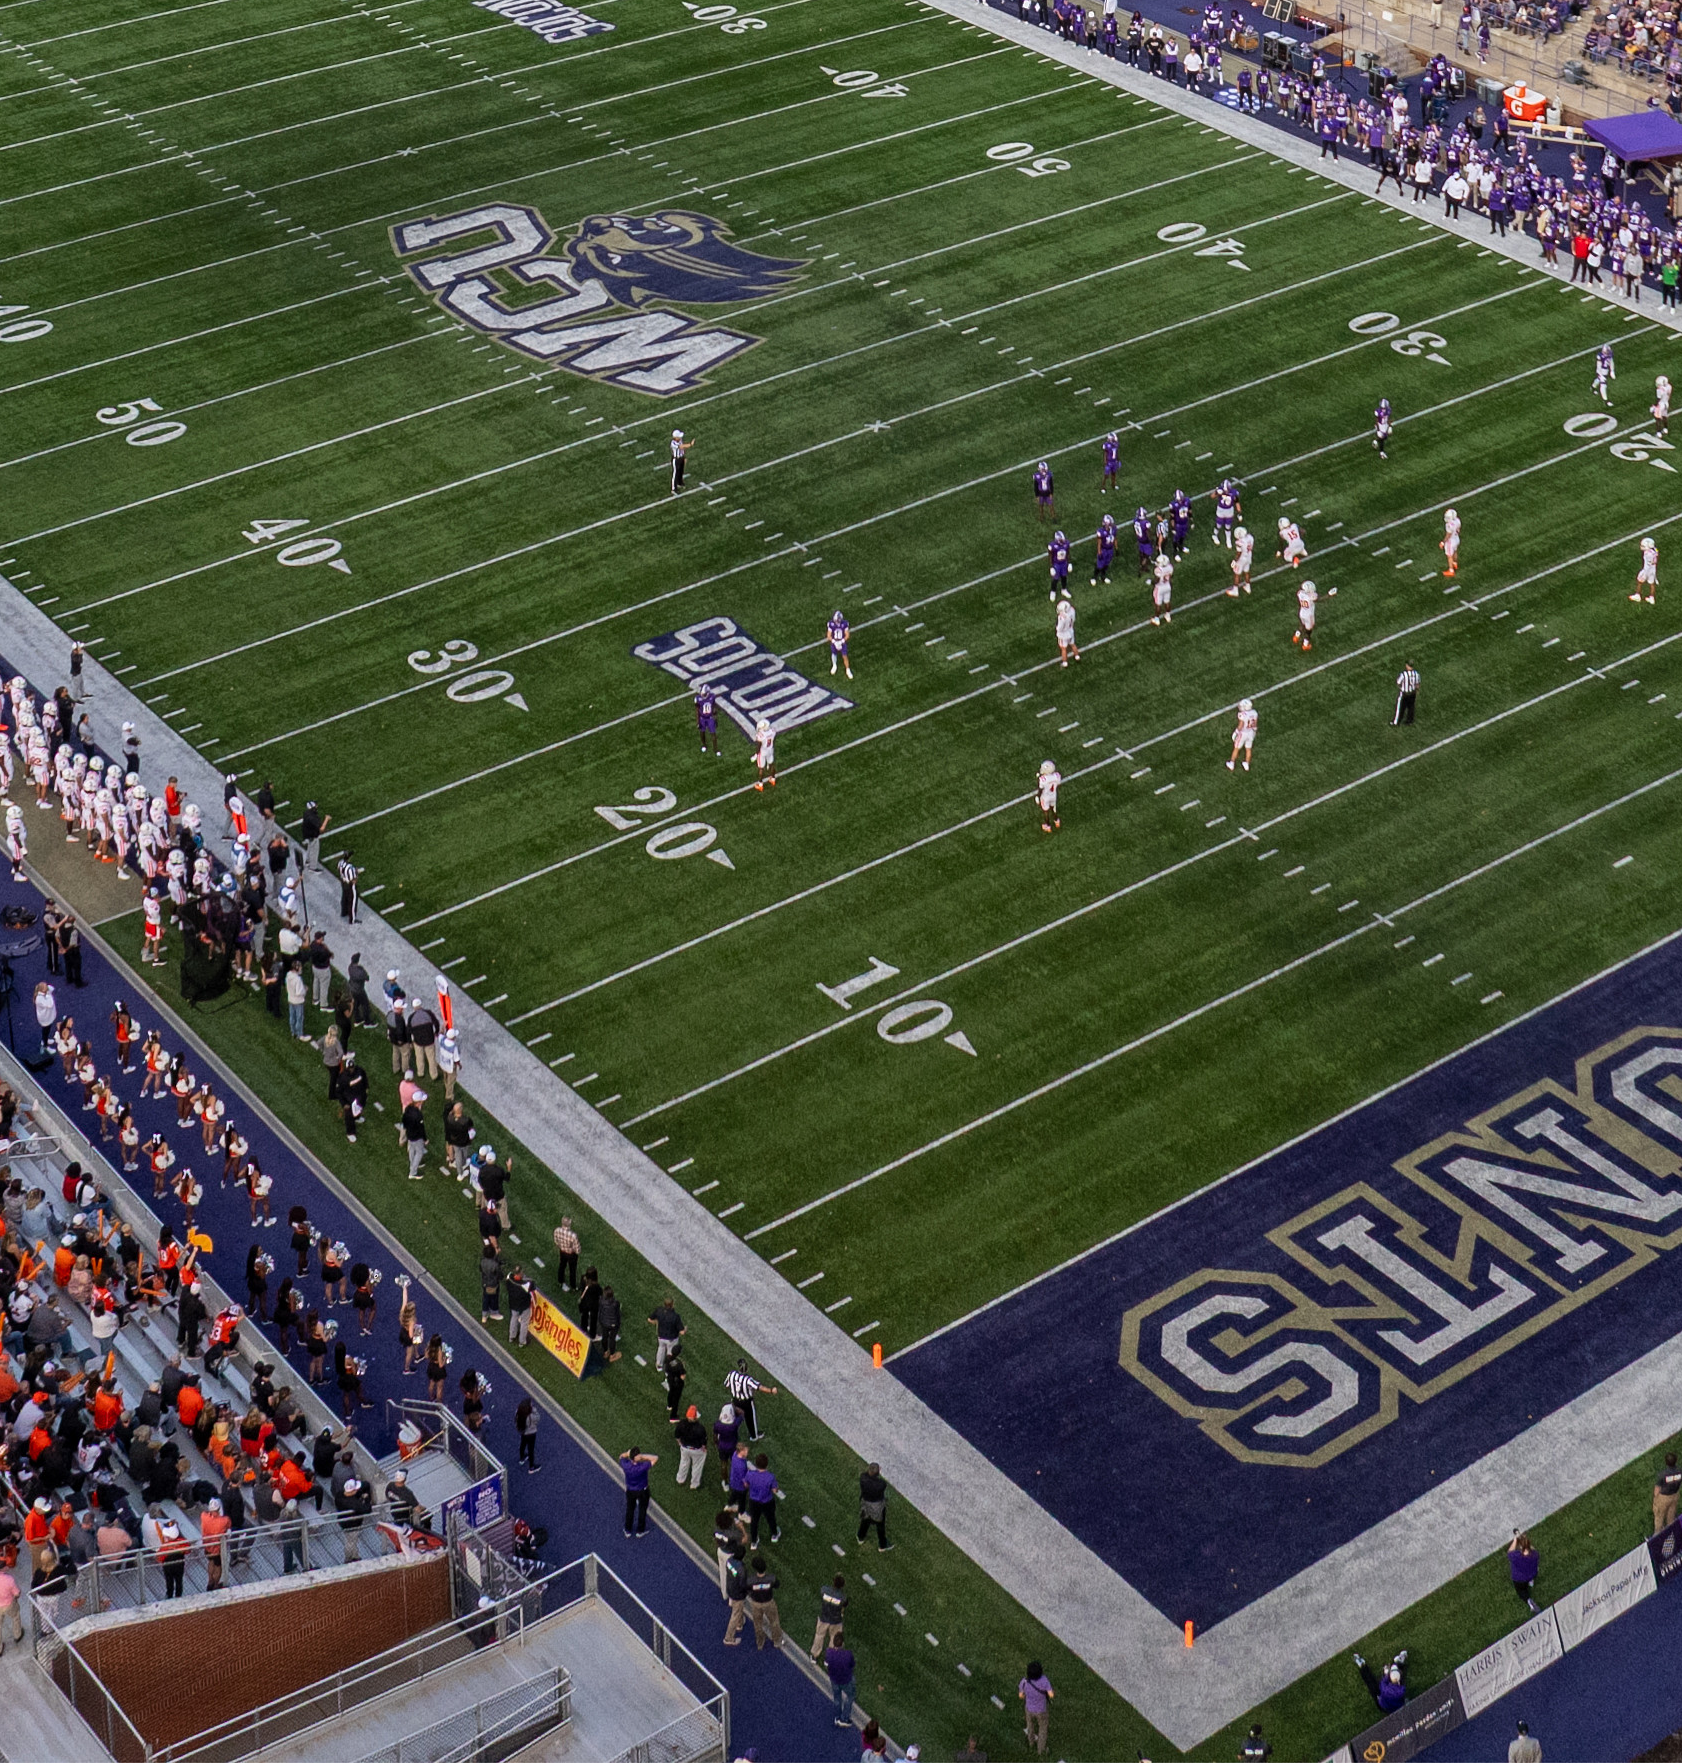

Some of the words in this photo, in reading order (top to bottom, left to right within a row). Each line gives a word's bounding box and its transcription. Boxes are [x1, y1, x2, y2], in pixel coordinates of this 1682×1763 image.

[694, 5, 768, 35] 30
[832, 69, 911, 98] 40
[1508, 99, 1522, 116] G
[985, 141, 1073, 179] 50
[1156, 221, 1248, 257] 40
[392, 201, 760, 394] WCU
[1347, 312, 1449, 357] 30
[95, 397, 189, 446] 50
[1563, 412, 1676, 462] 20
[240, 517, 344, 568] 40
[406, 639, 516, 704] 30
[633, 616, 856, 743] SOCON
[593, 785, 719, 860] 20
[815, 955, 954, 1045] 10
[531, 1302, 582, 1361] ojangles
[1581, 1590, 1611, 1616] Jackson
[1610, 1574, 1633, 1598] Paper
[1632, 1564, 1649, 1586] Mfg
[1458, 1646, 1503, 1686] HARRIS
[1510, 1615, 1553, 1652] SWAIN
